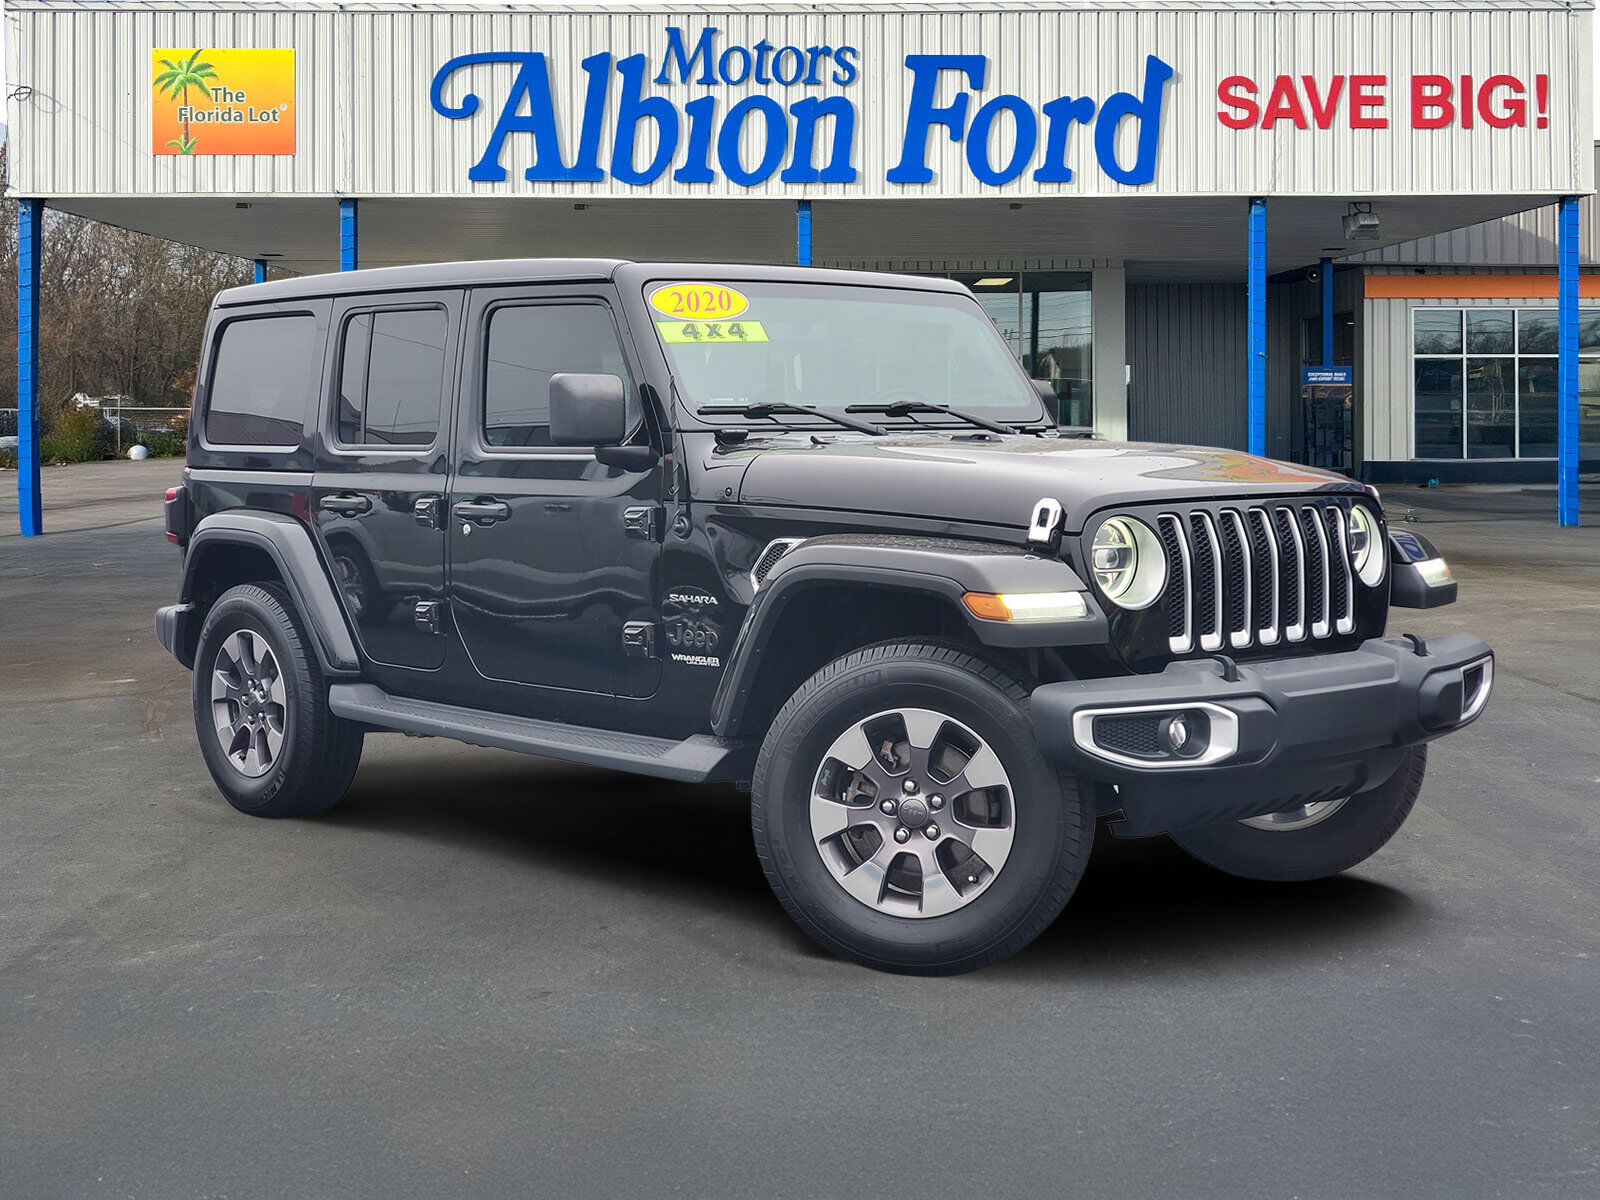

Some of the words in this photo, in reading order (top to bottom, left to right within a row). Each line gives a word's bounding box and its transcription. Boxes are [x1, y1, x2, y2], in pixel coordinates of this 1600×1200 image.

[653, 27, 858, 86] Motors
[211, 87, 245, 103] The
[1217, 75, 1389, 130] SAVE
[1411, 74, 1548, 130] BIG!
[177, 106, 243, 123] Florida
[248, 107, 279, 123] Lot
[430, 52, 858, 186] Albion
[886, 54, 1174, 186] Ford
[671, 290, 732, 313] 2020
[669, 593, 719, 605] SAHARA
[666, 622, 719, 654] Jeep
[671, 653, 720, 664] WRANGLER
